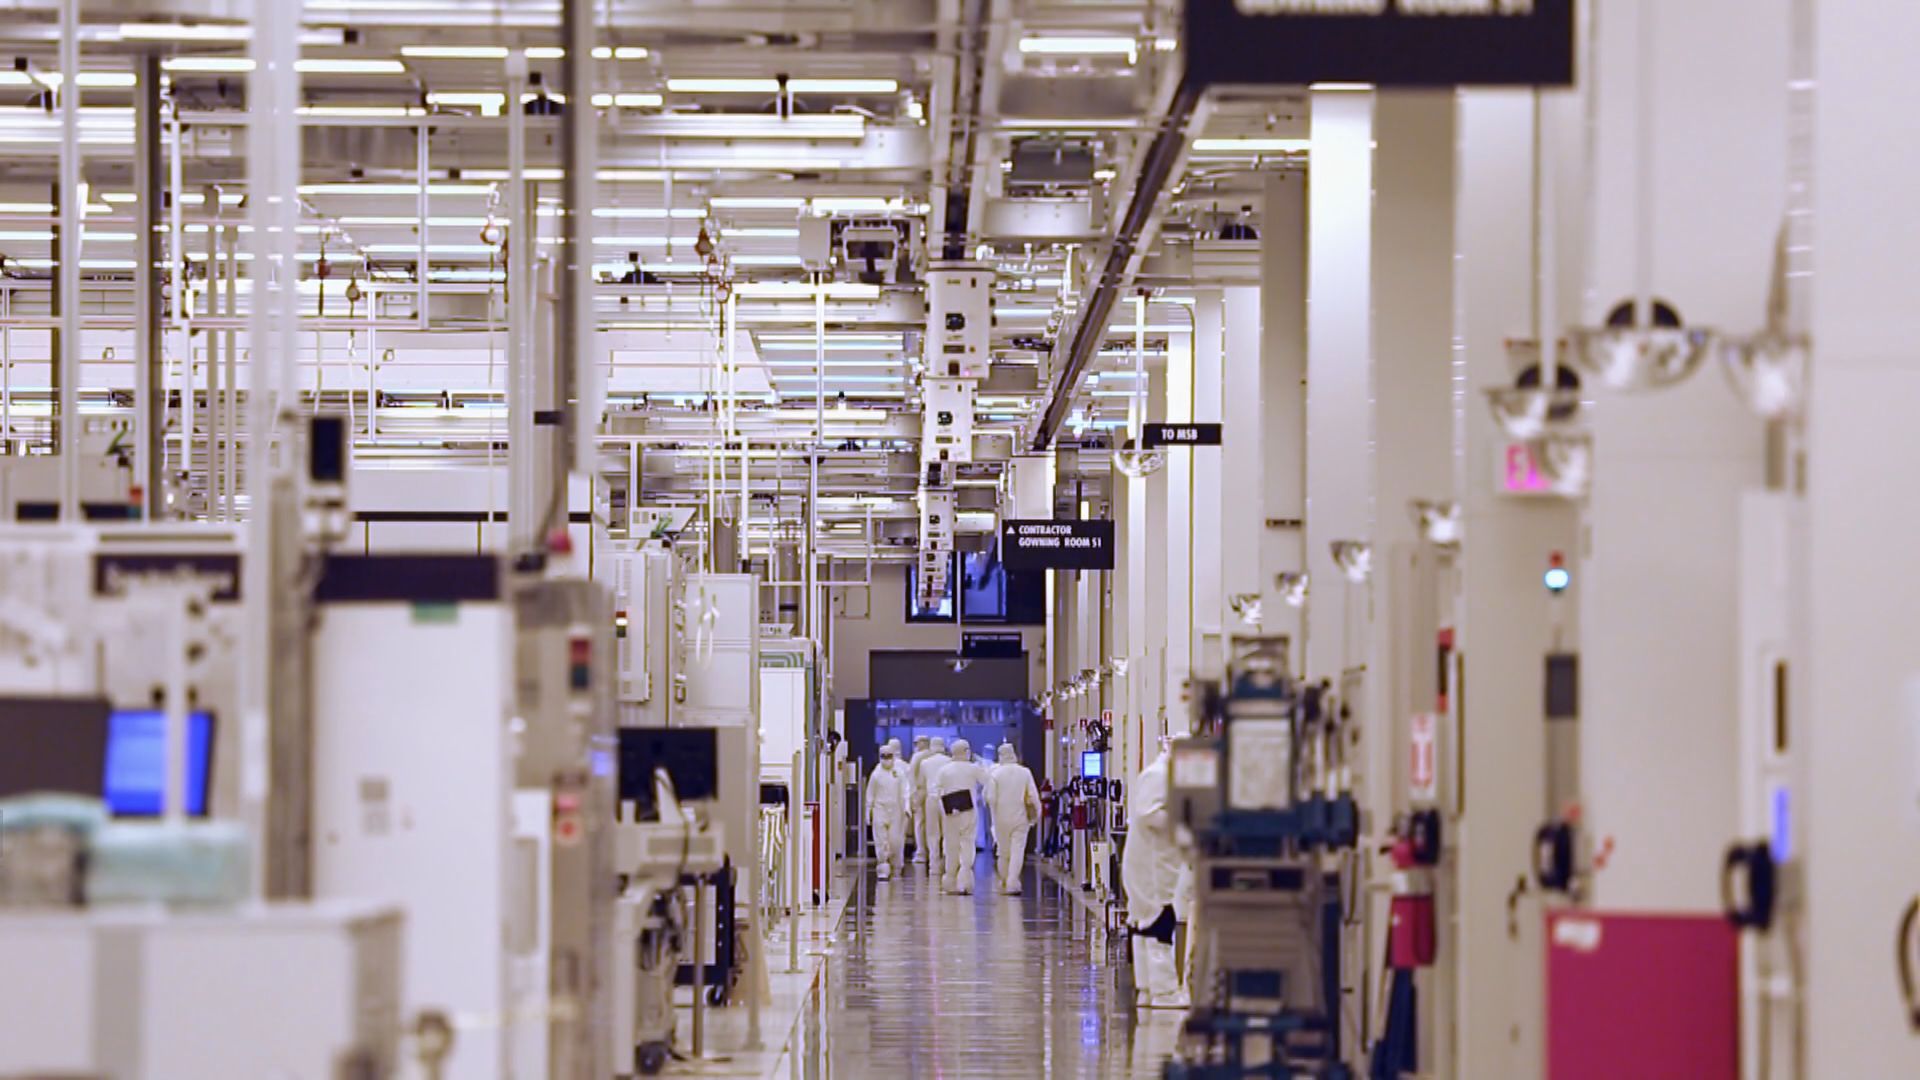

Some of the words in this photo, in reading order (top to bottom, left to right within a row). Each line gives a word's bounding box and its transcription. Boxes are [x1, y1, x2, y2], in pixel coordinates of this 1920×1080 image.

[1161, 428, 1175, 440] TO
[1019, 524, 1072, 535] CONTRACTOR
[1019, 537, 1060, 548] GOWNING
[1064, 537, 1090, 548] ROOM
